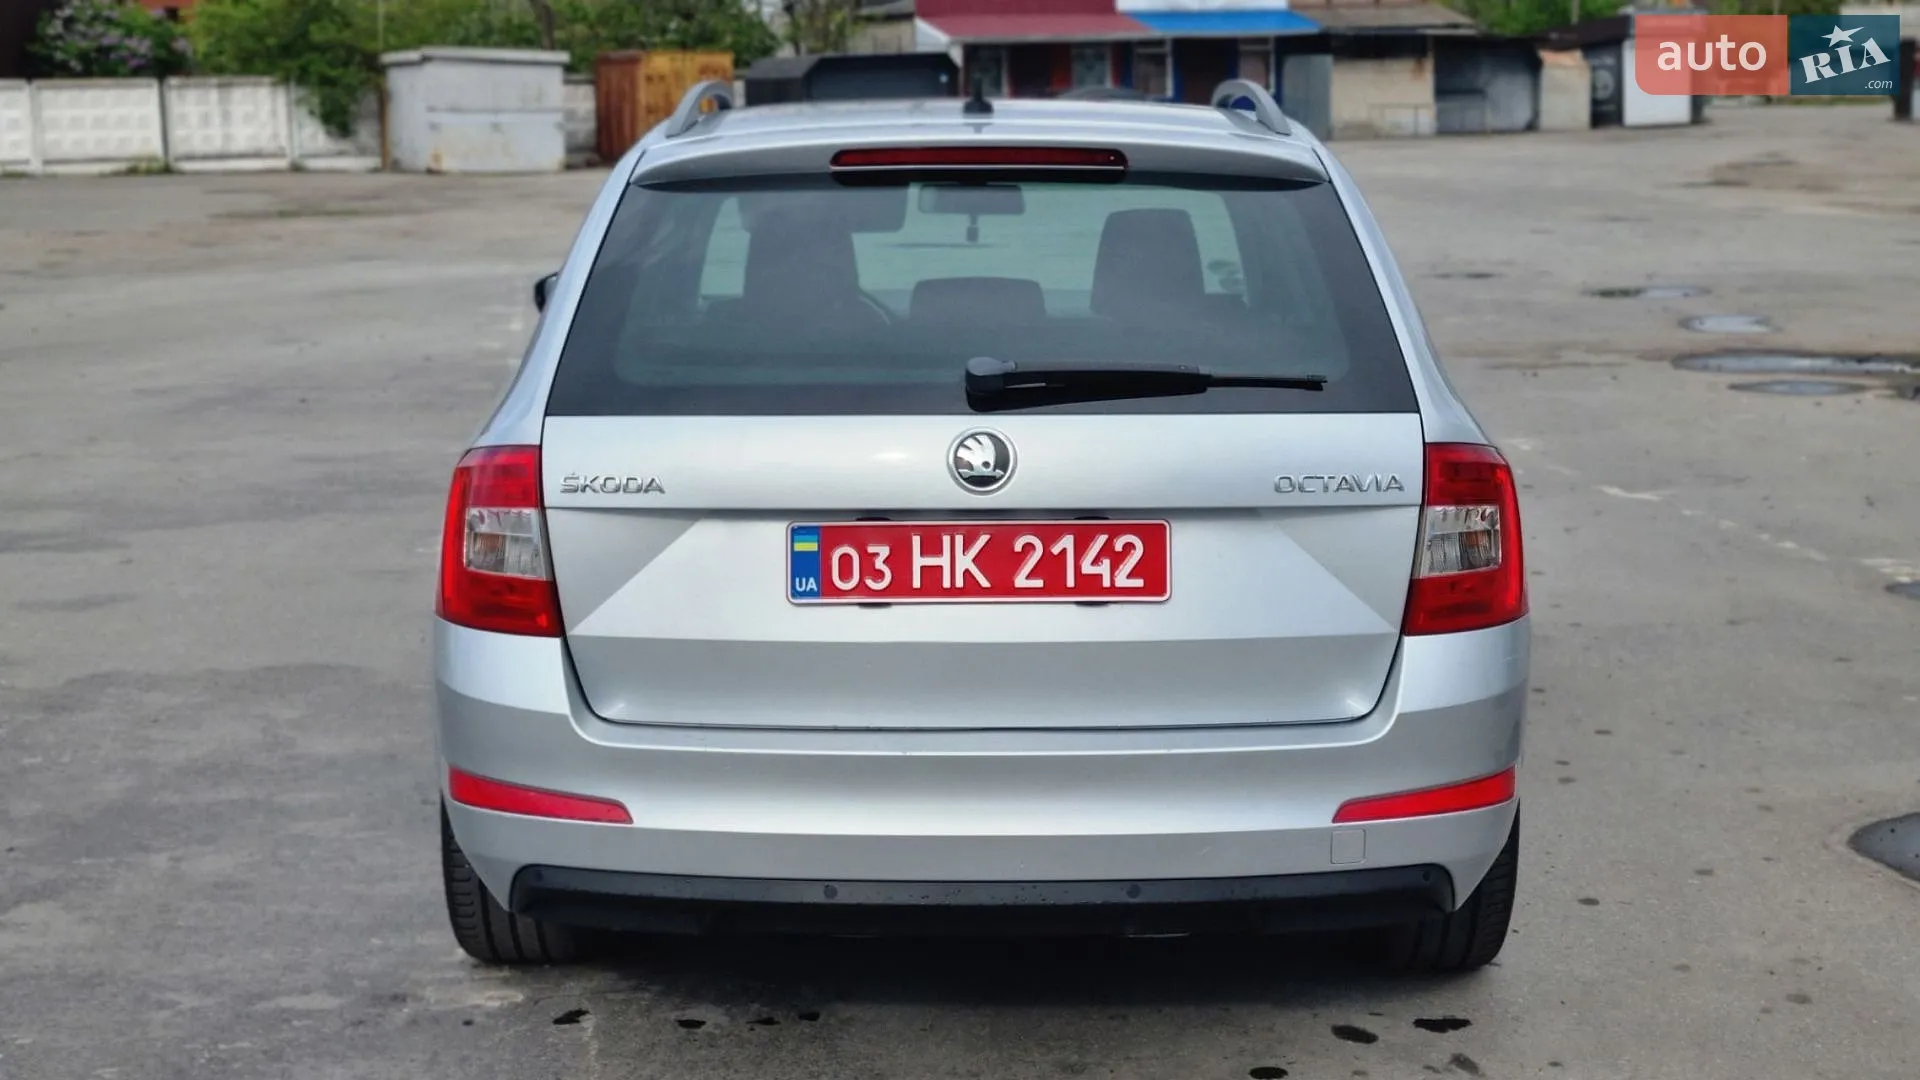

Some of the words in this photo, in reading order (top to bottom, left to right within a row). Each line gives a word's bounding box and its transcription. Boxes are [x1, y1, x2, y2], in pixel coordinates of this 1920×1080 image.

[560, 472, 665, 495] ŠKODA
[1274, 472, 1405, 494] OCTAVIA
[831, 546, 892, 591] 03
[911, 534, 992, 590] HK
[1012, 534, 1146, 590] 2142
[795, 577, 819, 592] UA
